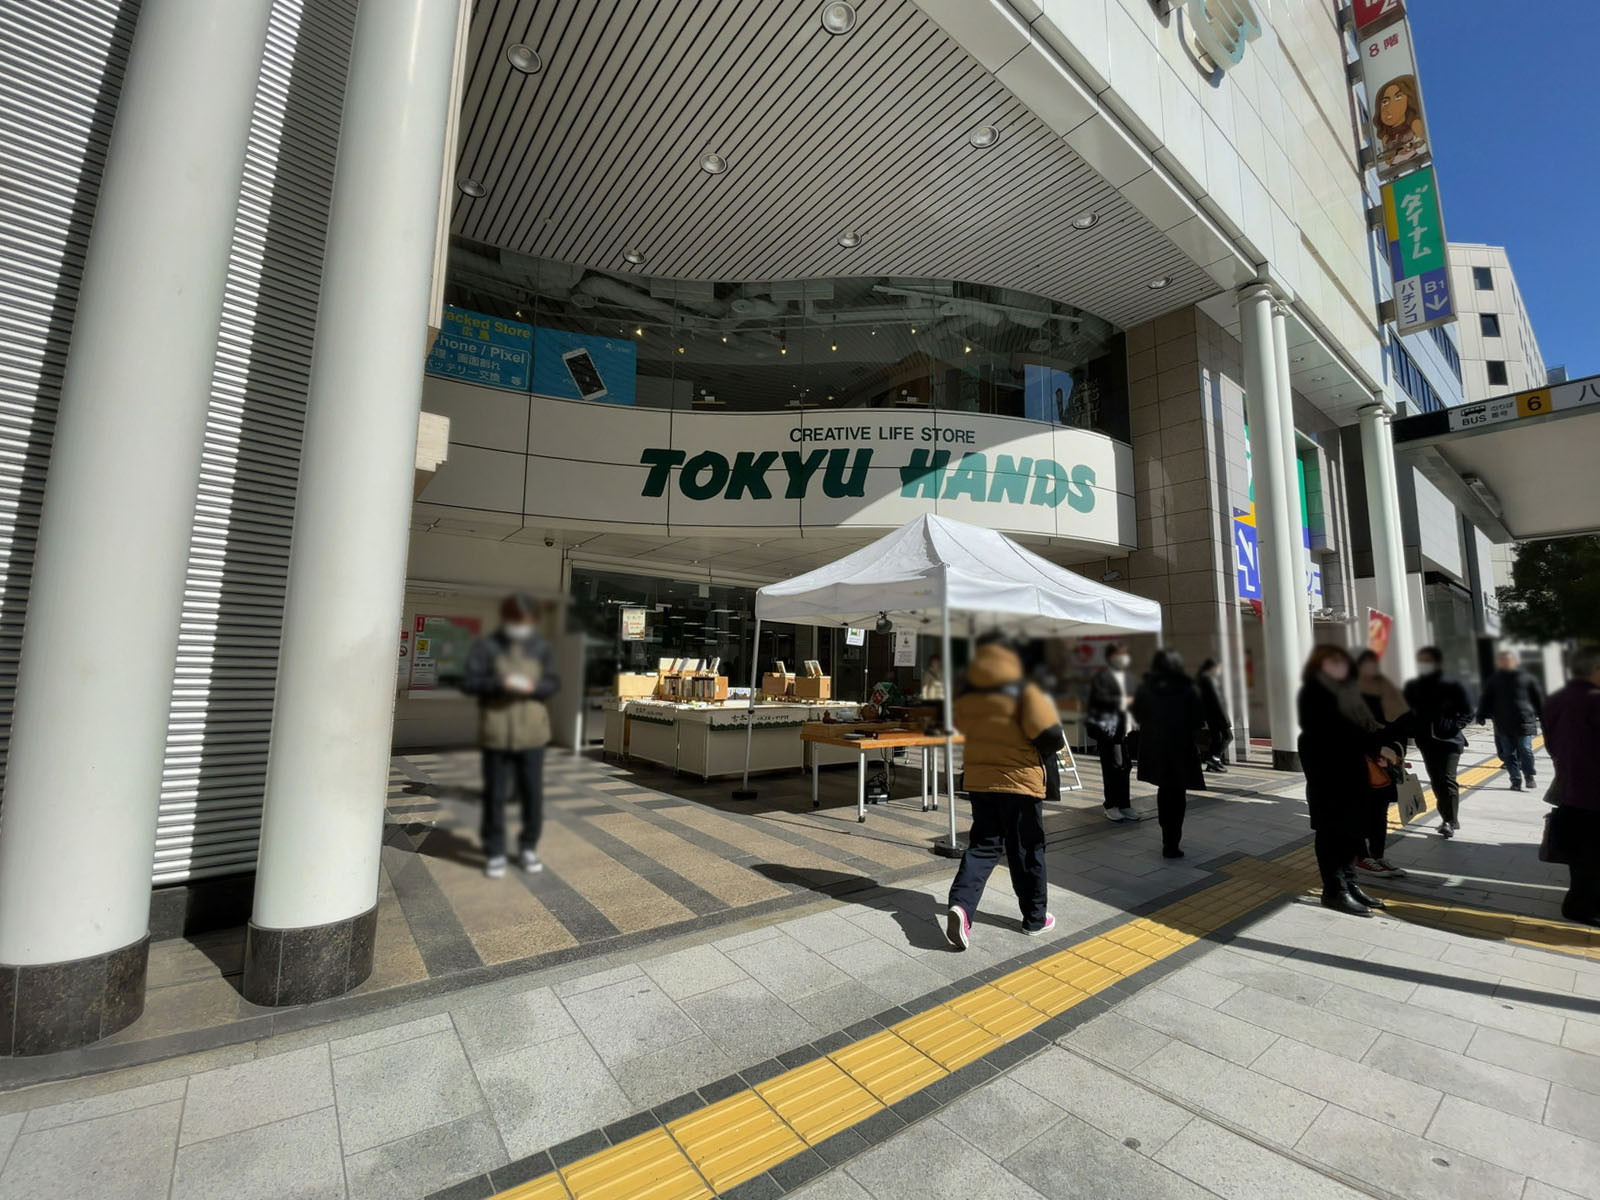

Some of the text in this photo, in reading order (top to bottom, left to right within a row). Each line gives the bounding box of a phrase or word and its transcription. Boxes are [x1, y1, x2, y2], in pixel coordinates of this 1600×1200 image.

[1400, 184, 1433, 260] ダイナム
[1424, 280, 1445, 294] B1
[495, 321, 531, 338] Store
[490, 347, 525, 364] Pixel
[1527, 396, 1542, 411] 6
[1462, 415, 1487, 426] BUS
[790, 427, 976, 444] CREATIVE LIFE STORE
[640, 448, 1097, 514] TOKYU HANDS
